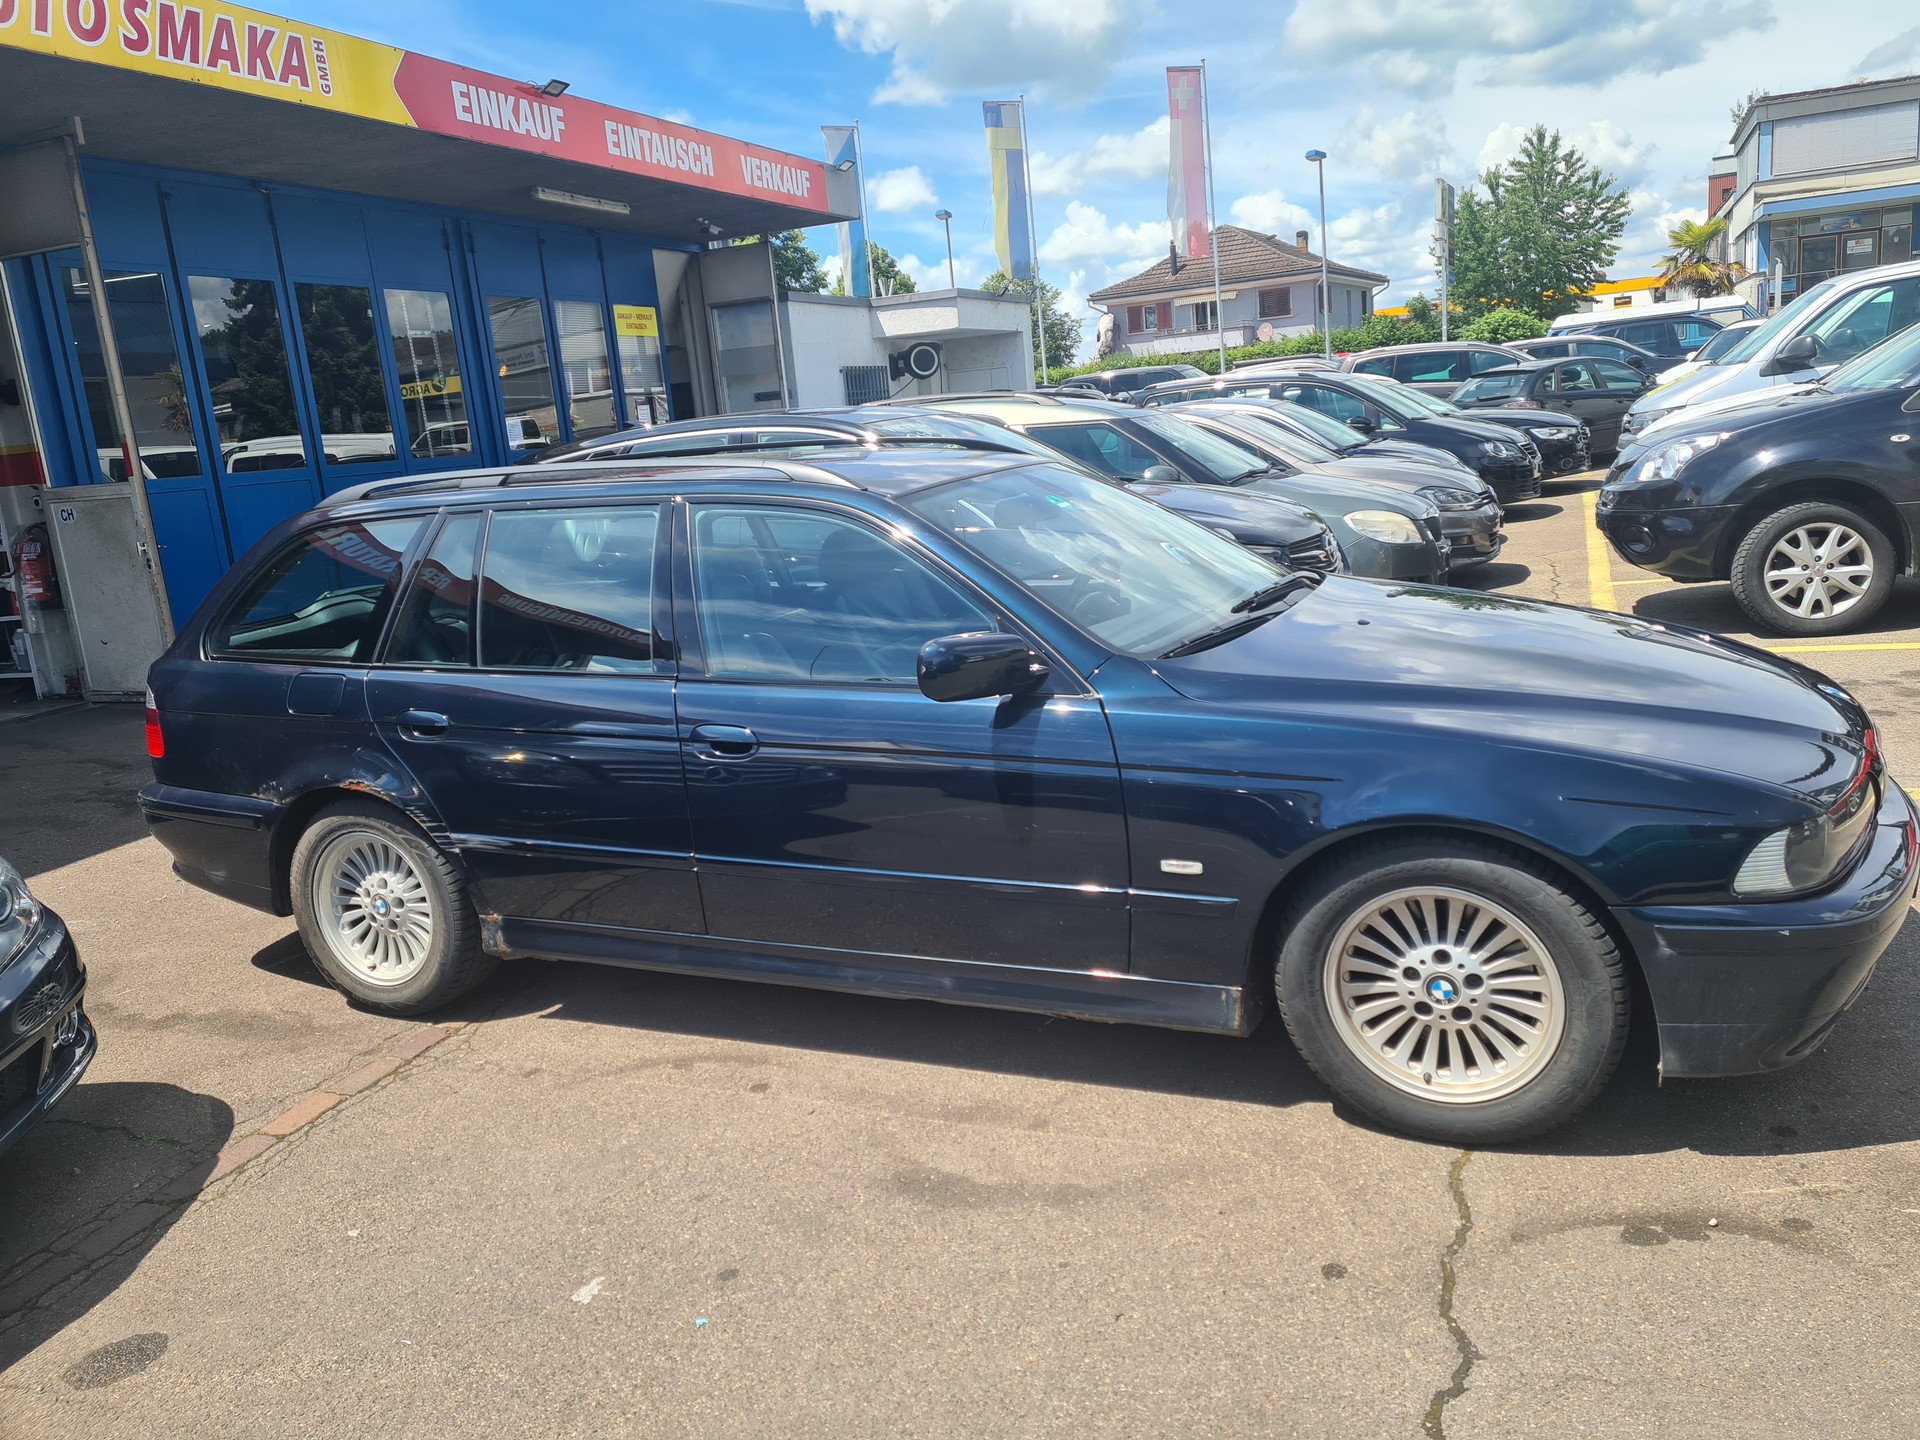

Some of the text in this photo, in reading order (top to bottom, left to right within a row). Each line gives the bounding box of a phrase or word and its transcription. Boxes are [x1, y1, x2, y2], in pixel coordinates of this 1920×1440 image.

[119, 0, 311, 90] SMAKA
[312, 39, 332, 95] GMBH
[451, 81, 810, 198] EINKAUF EINTAUSCH VERKAUF
[60, 507, 75, 522] CH
